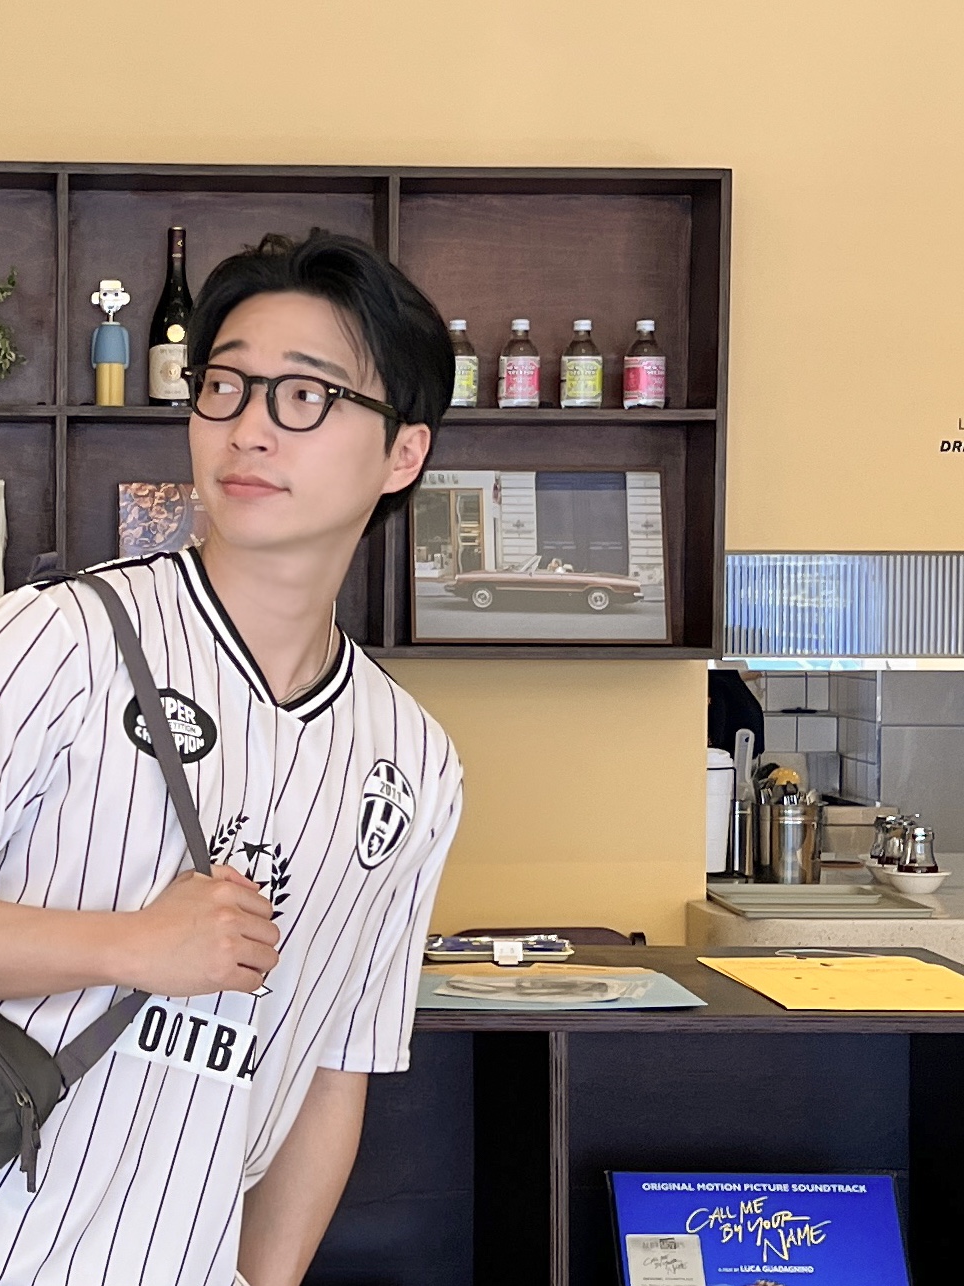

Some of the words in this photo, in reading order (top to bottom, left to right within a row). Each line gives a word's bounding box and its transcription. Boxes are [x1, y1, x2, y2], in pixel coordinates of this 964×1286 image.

[940, 440, 964, 452] DR
[379, 780, 402, 804] 2011
[641, 1182, 695, 1192] ORIGINAL
[696, 1183, 742, 1192] MOTION
[743, 1184, 789, 1193] PICTURE
[791, 1184, 867, 1194] SOUNDTRACK
[685, 1206, 736, 1234] CALL
[739, 1196, 769, 1224] ME
[719, 1222, 743, 1244] BY
[746, 1210, 811, 1247] YOUR
[762, 1220, 832, 1263] NAME
[739, 1265, 763, 1273] LUCA
[762, 1265, 815, 1274] GUADAGNINO
